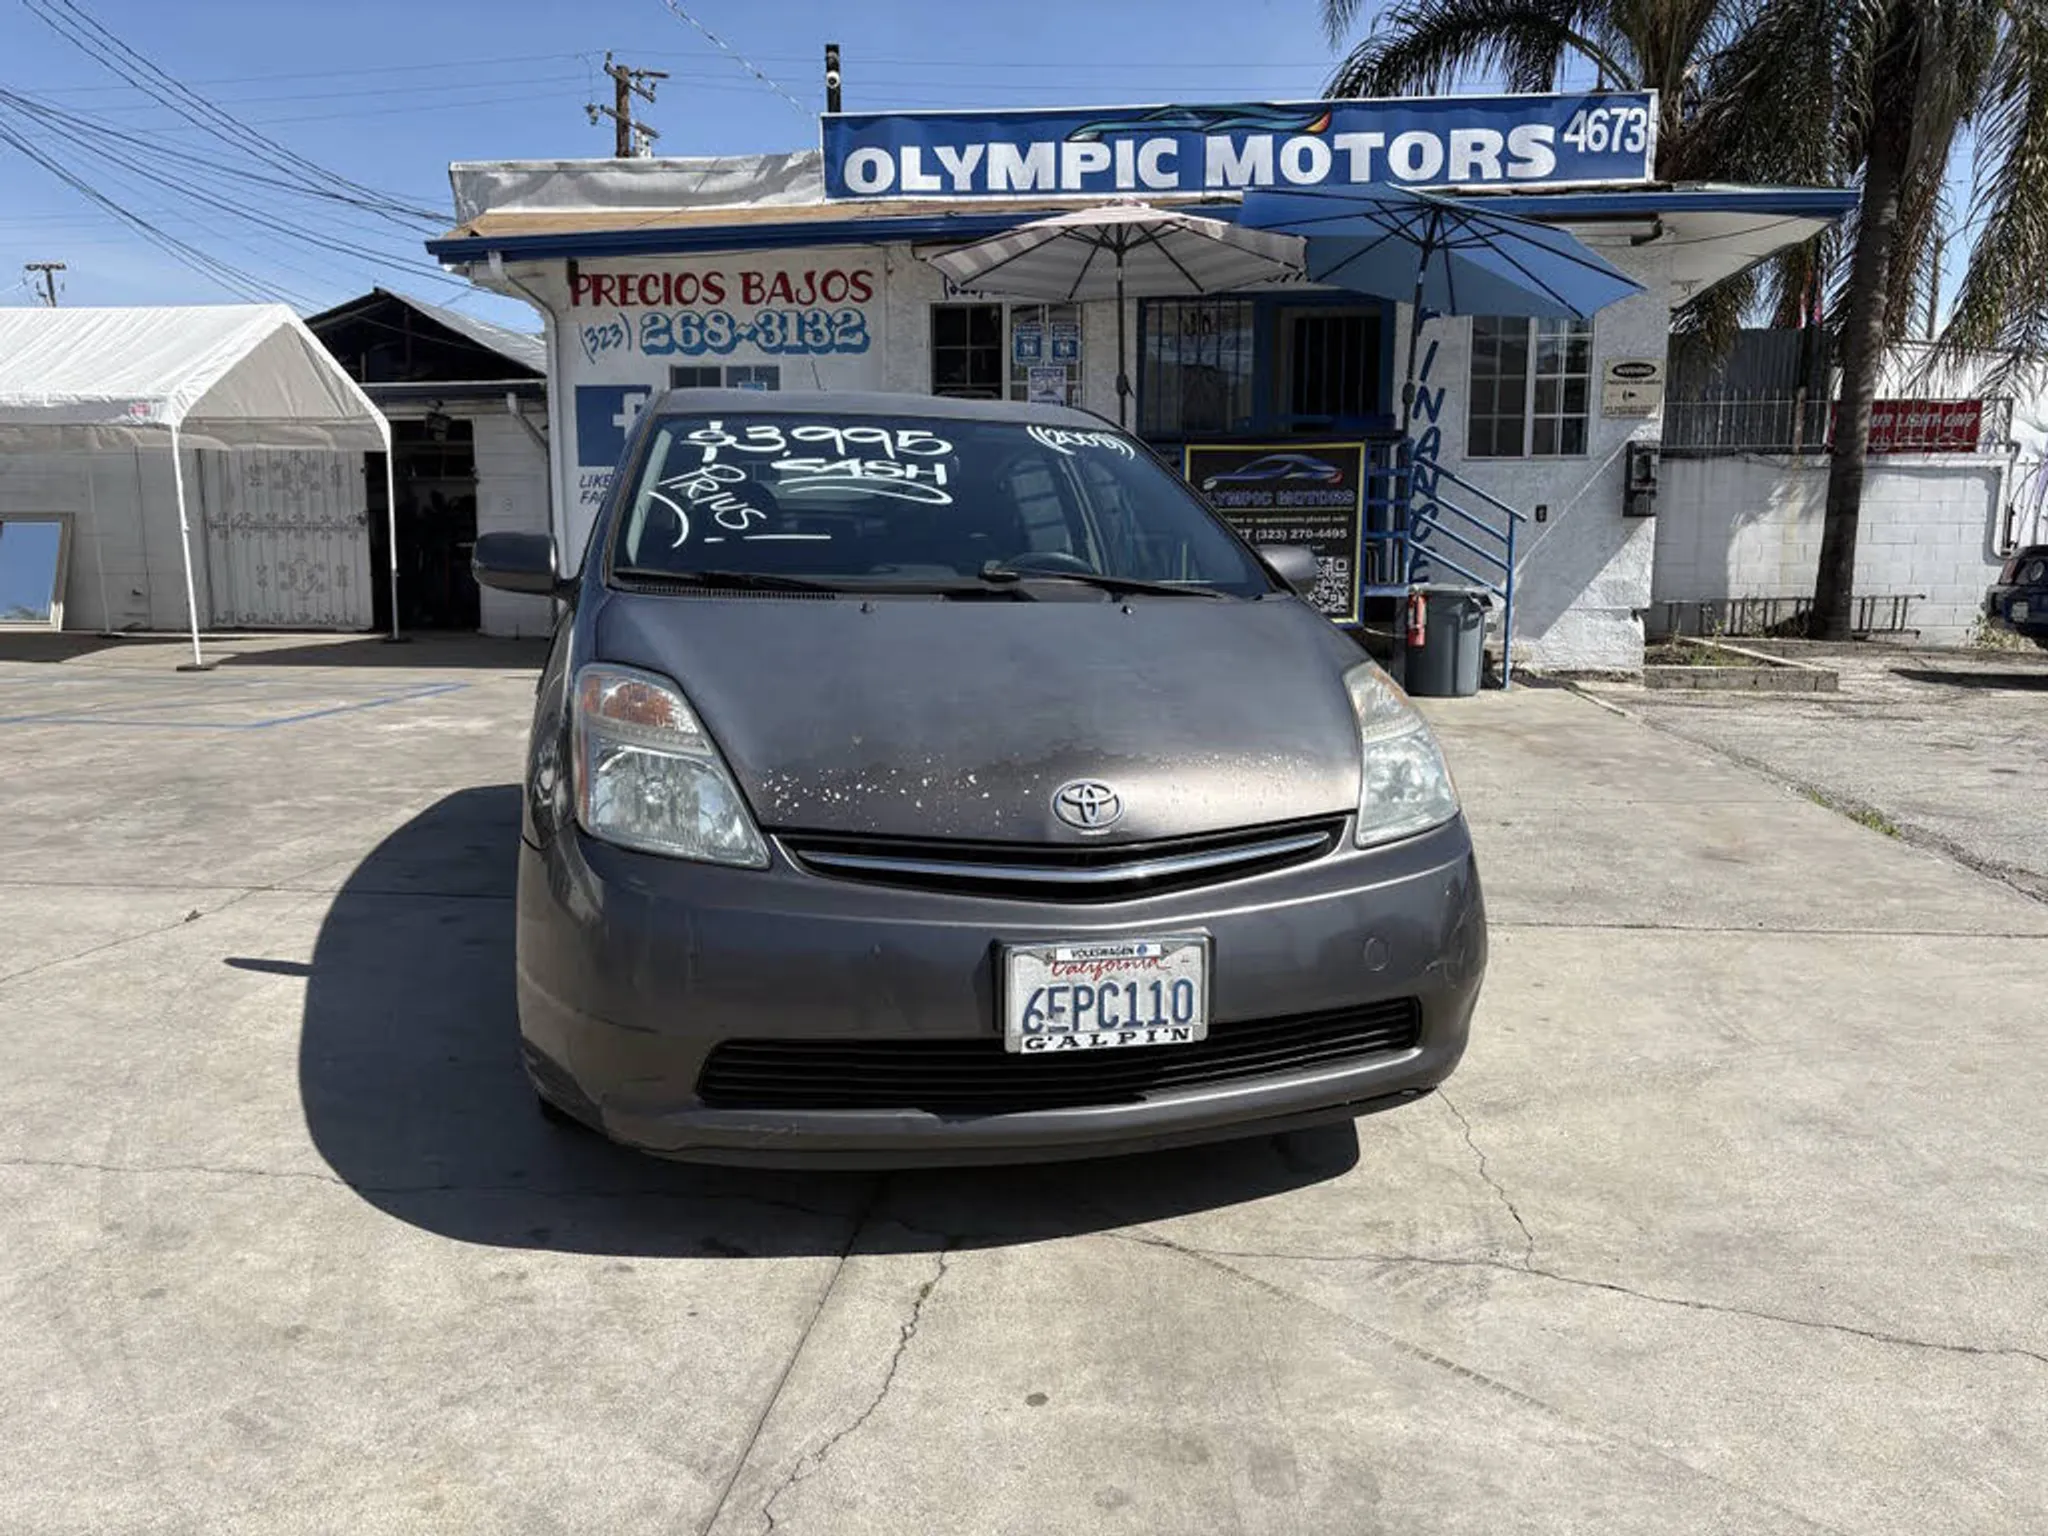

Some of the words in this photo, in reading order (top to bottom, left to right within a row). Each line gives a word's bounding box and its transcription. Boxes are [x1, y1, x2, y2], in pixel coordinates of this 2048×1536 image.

[1563, 107, 1647, 153] 4673
[844, 137, 1178, 194] OLYMPIC
[1206, 124, 1556, 187] MOTORS
[570, 271, 726, 307] PRECIOS
[738, 270, 874, 305] BAJOS
[578, 312, 633, 365] (323)
[1203, 490, 1273, 506] LYMPIC
[1256, 529, 1287, 541] (323)
[1051, 958, 1171, 981] California
[1071, 947, 1134, 958] VOLKSWAGEN
[1022, 978, 1194, 1034] 6EPC110
